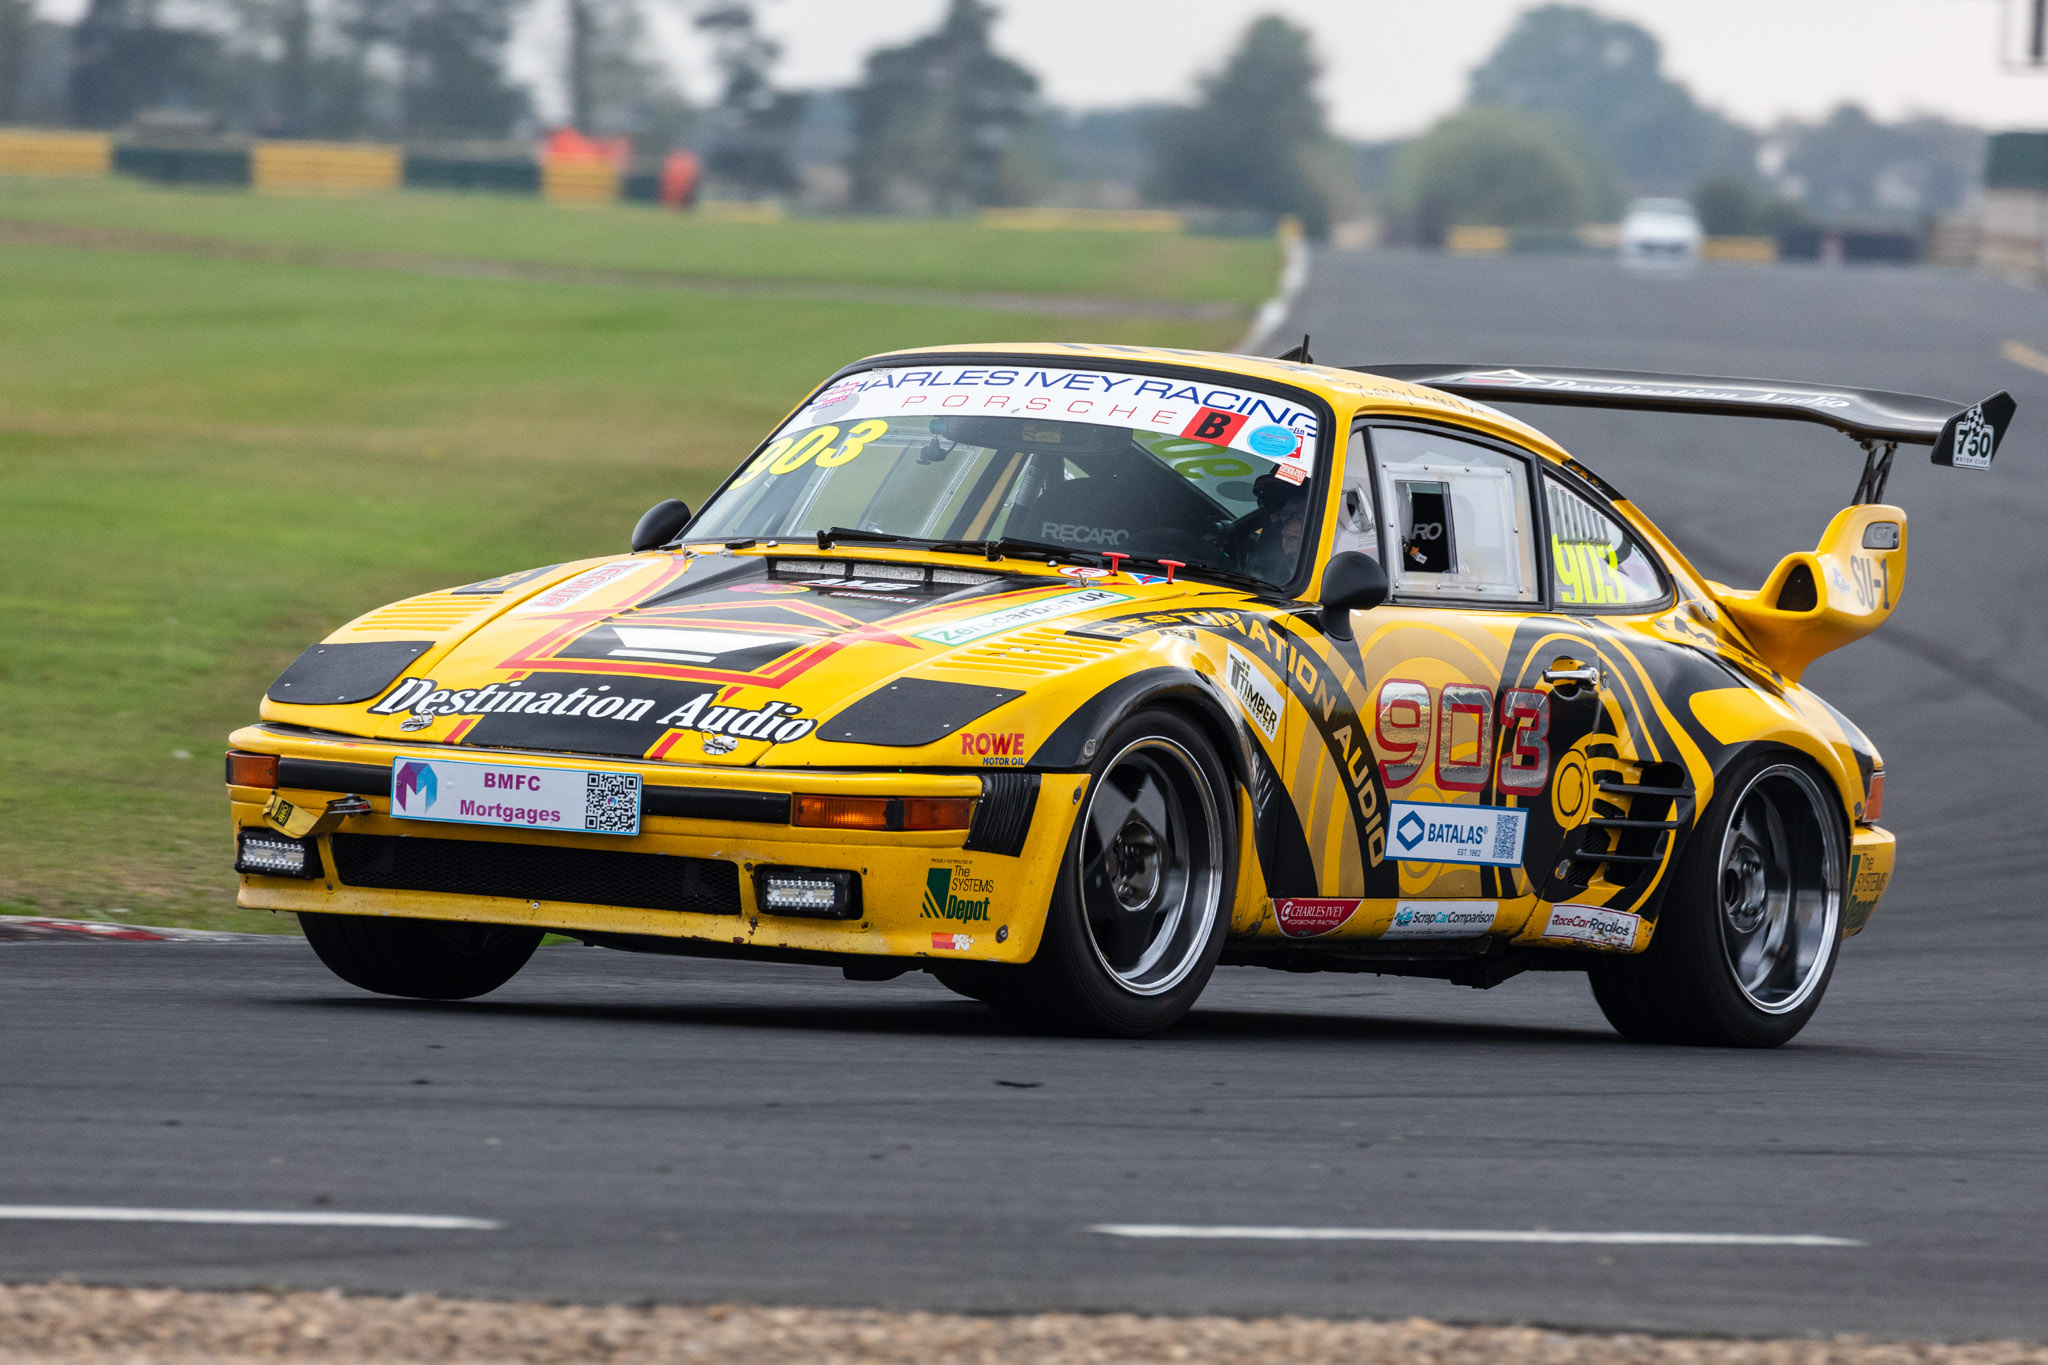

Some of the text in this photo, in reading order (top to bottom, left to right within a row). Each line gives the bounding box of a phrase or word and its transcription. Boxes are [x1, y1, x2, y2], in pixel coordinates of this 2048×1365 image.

[901, 395, 1178, 425] PORSCHE
[1023, 371, 1133, 394] IVEY
[1134, 379, 1317, 438] RACING
[1194, 411, 1232, 439] B
[728, 419, 888, 490] 903
[1959, 429, 1991, 458] 750
[1552, 533, 1627, 604] 903
[1850, 554, 1890, 610] SU-1
[374, 678, 815, 743] Destination Audio
[1239, 671, 1278, 730] TIMBER
[1239, 689, 1276, 737] TECHNOLOGY
[960, 732, 1025, 755] ROWE
[1093, 610, 1387, 869] DESTINATION AUDIO
[1375, 677, 1551, 797] 903
[982, 757, 1026, 766] MOTOR OIL
[483, 772, 541, 792] BMFC
[460, 799, 561, 824] Mortgages
[951, 877, 994, 894] SYSTEMS
[955, 865, 970, 878] The
[1290, 906, 1345, 919] CHARLES IVEY
[1412, 910, 1495, 925] ScrapCarComparison
[1552, 913, 1630, 937] RaceCarRadios
[952, 933, 974, 951] K&N
